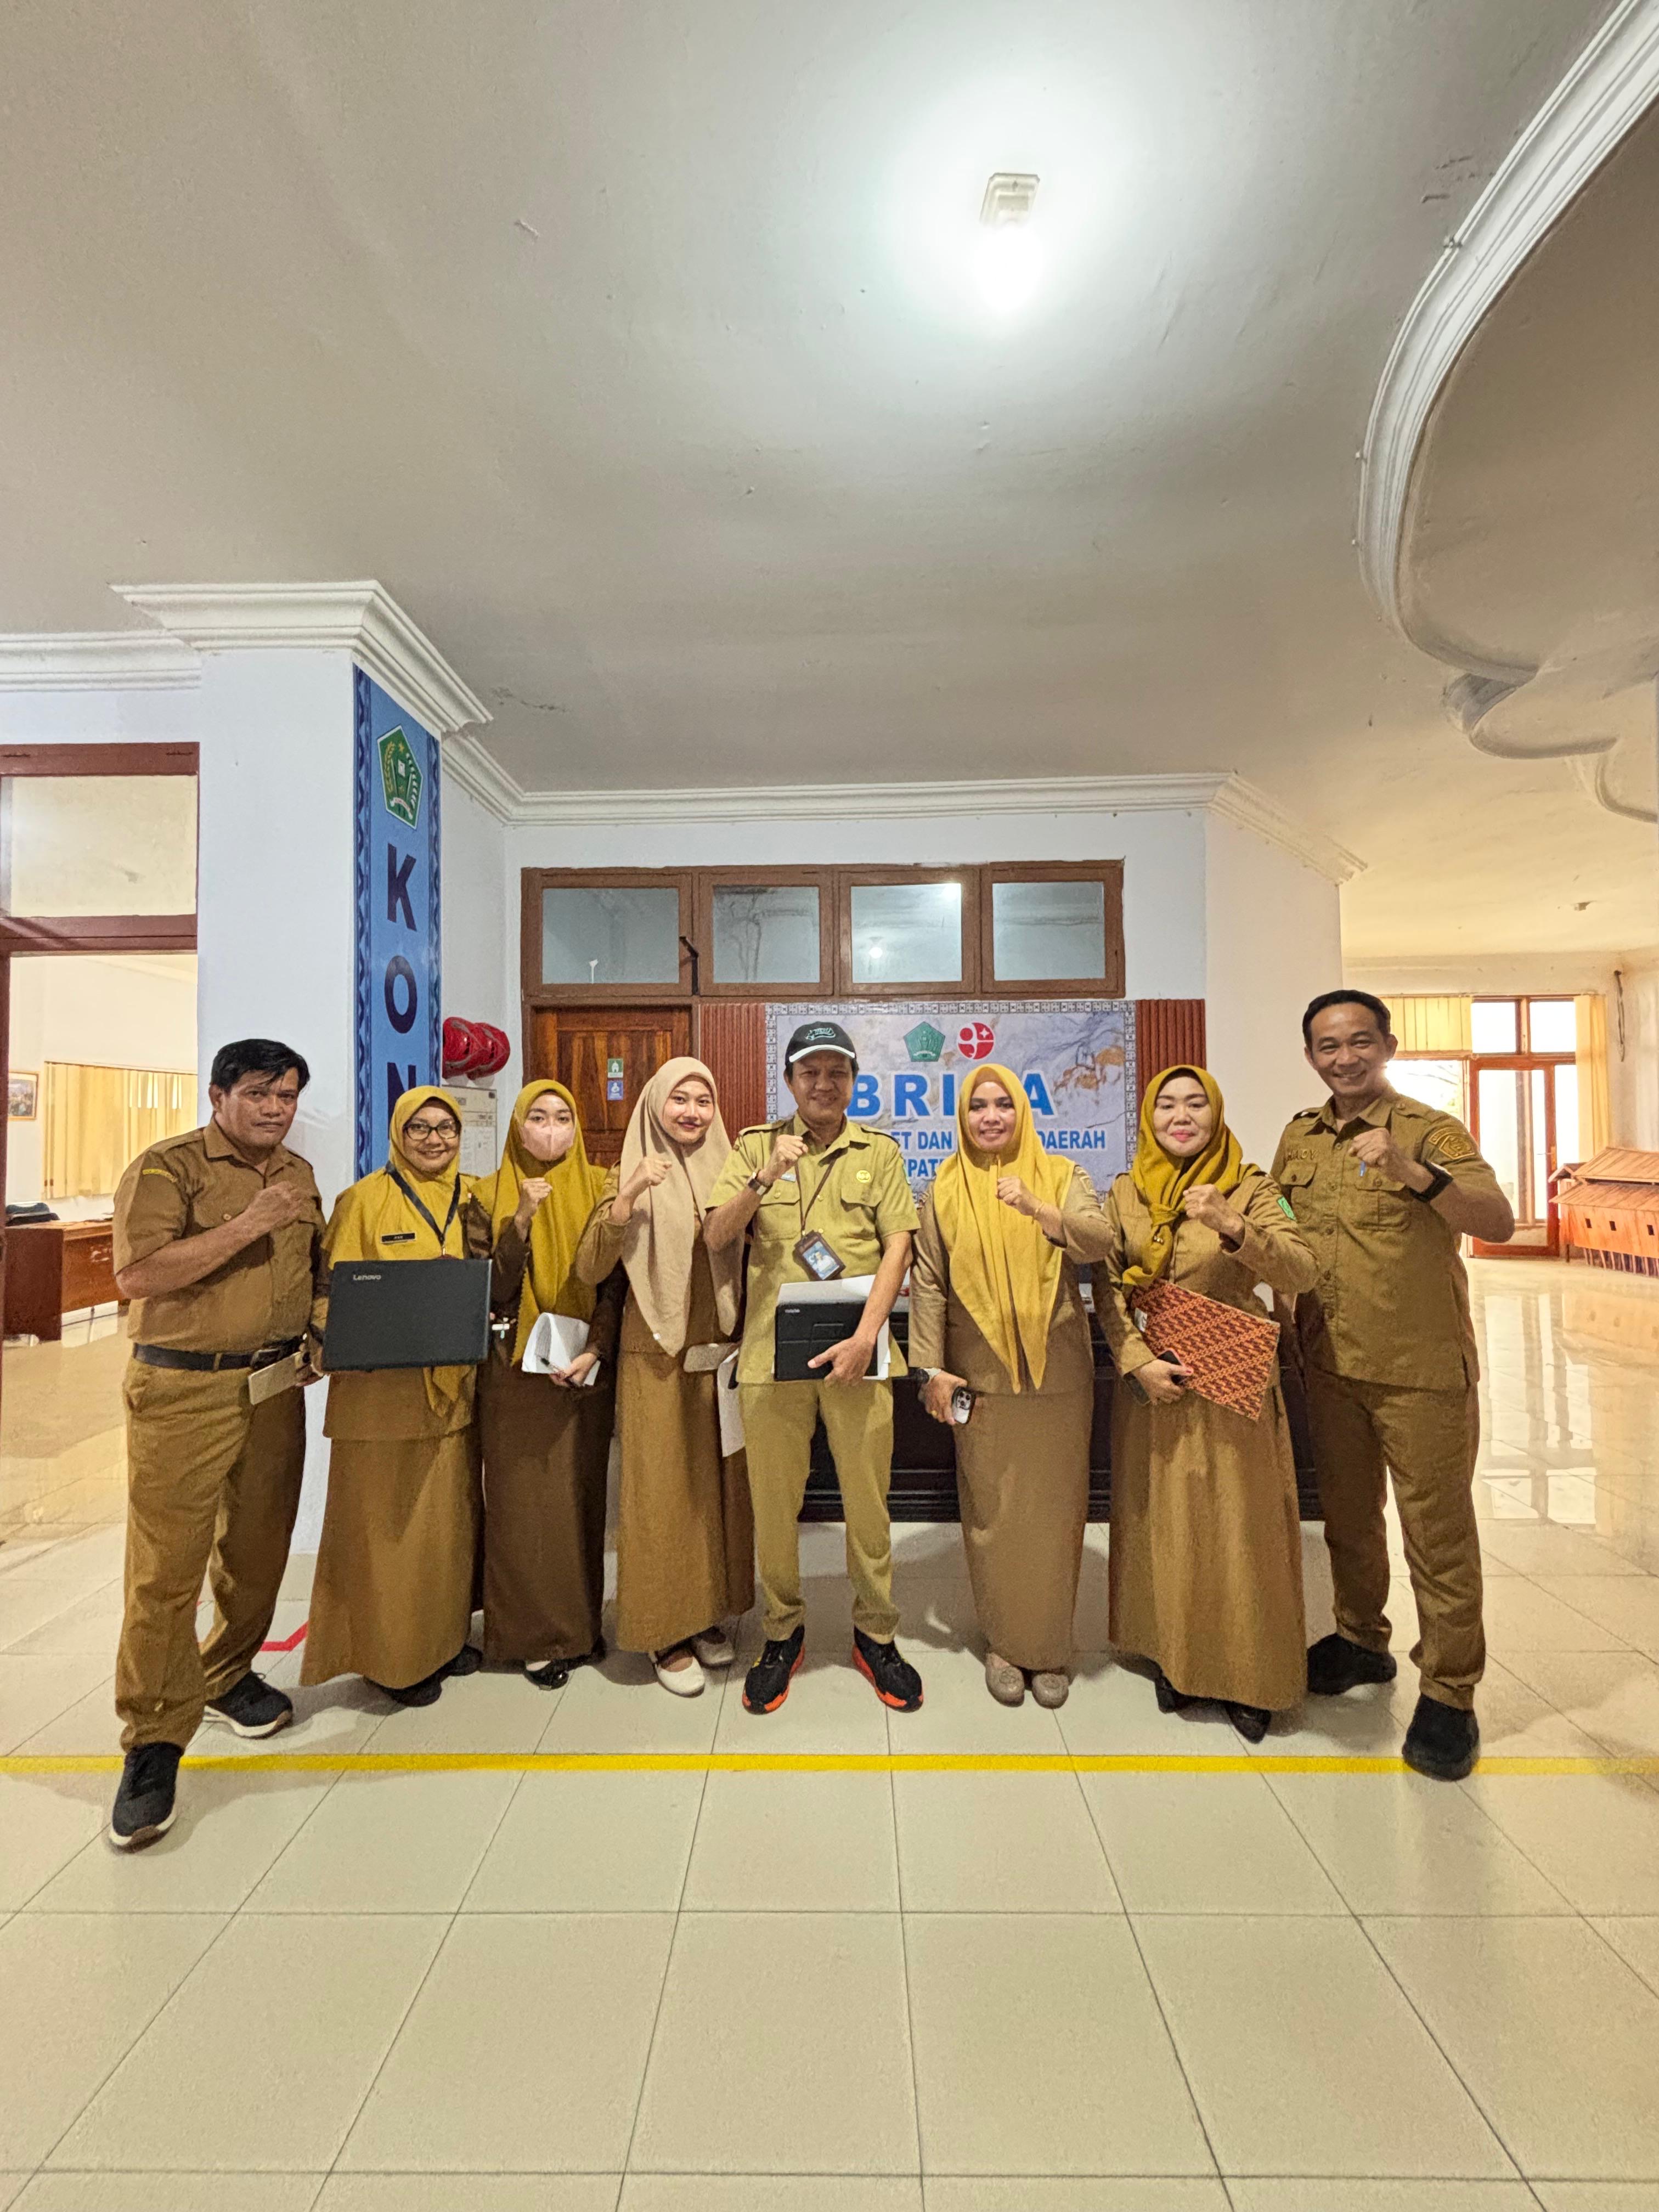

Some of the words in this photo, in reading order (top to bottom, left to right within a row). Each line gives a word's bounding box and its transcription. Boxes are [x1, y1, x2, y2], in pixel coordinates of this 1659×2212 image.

[847, 1074, 1055, 1116] BRIA
[917, 1131, 952, 1149] DAN
[904, 1158, 944, 1177] PAT
